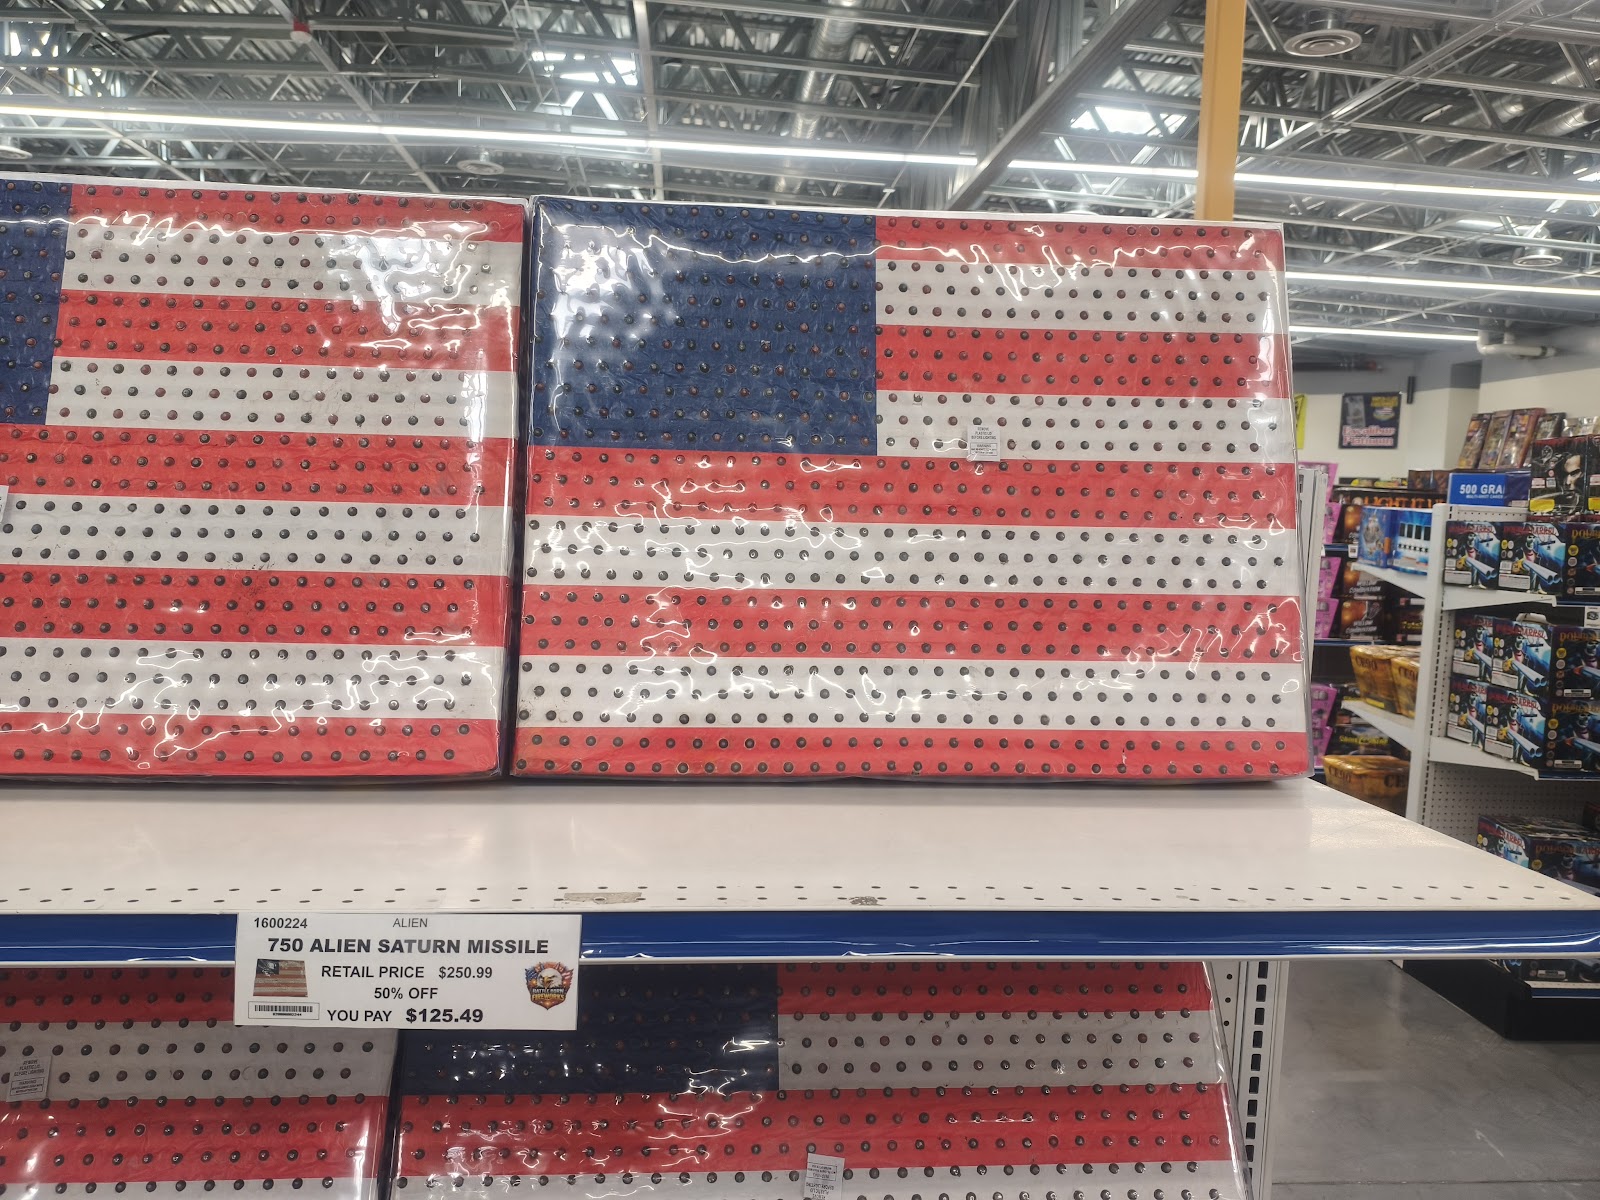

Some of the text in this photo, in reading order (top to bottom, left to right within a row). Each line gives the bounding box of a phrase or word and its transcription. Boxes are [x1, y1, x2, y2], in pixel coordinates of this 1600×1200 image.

[1460, 485, 1505, 494] 500 GRA
[254, 917, 428, 929] 1600224 ALIEN
[268, 938, 549, 954] 750 ALIEN SATURN MISSILE
[321, 965, 493, 980] RETAIL PRICE $250.99
[374, 987, 438, 999] 50% OFF
[327, 1007, 484, 1023] YOU PAY $125.49
